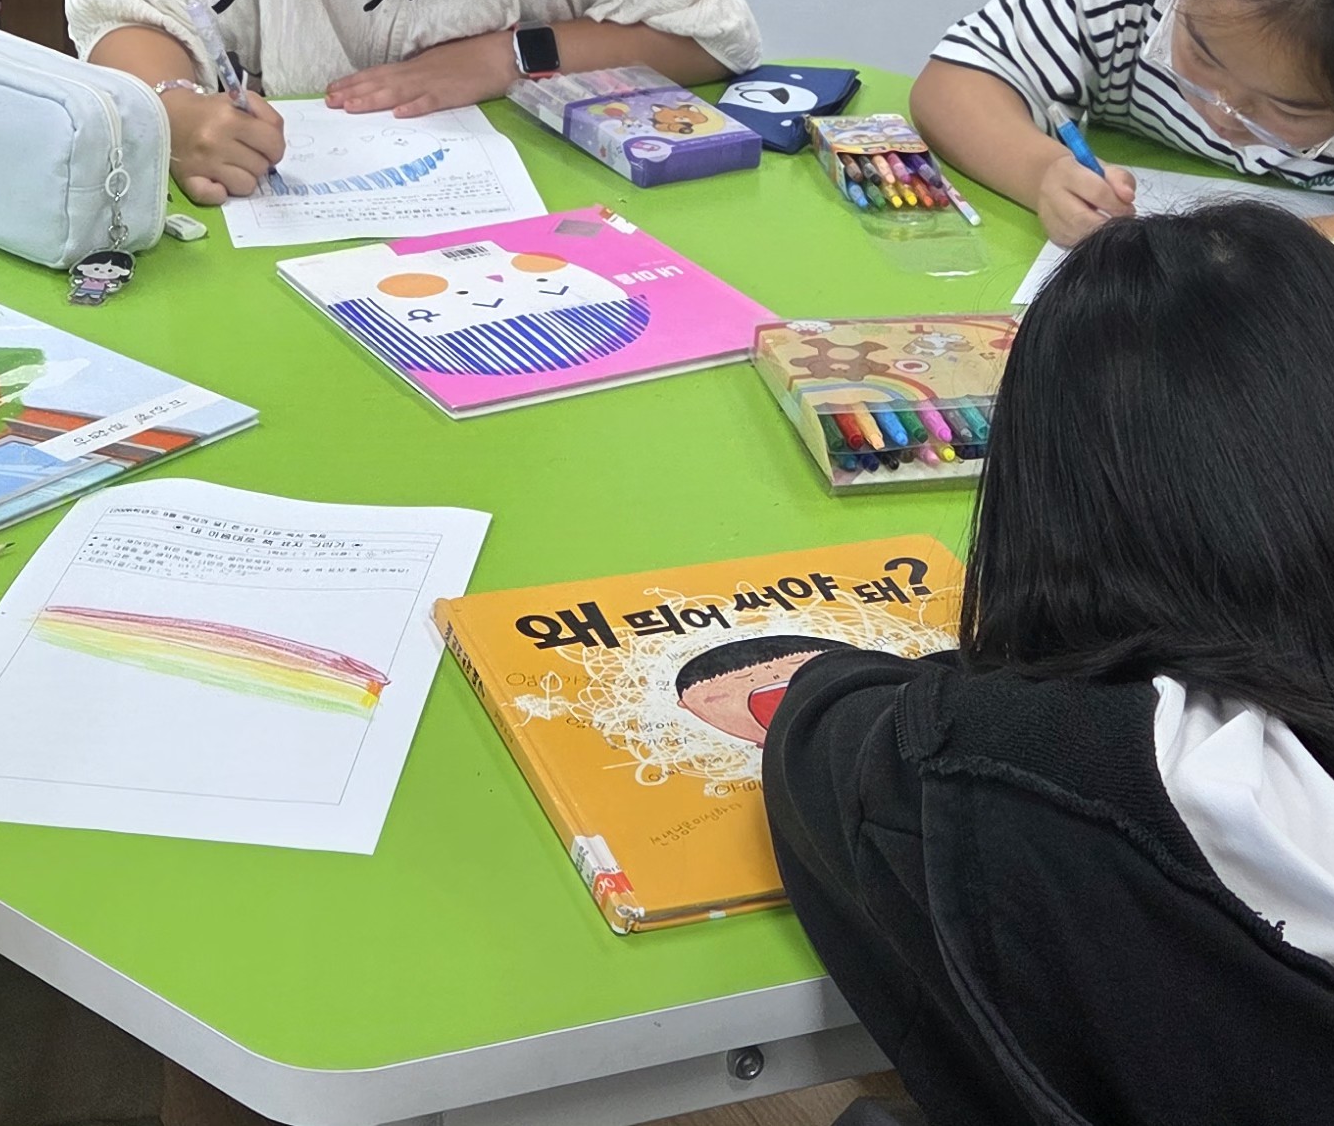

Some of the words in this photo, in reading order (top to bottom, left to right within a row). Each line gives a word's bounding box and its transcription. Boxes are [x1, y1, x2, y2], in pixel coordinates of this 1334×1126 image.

[653, 265, 684, 278] 내
[515, 601, 621, 651] 왜
[623, 604, 731, 636] 띄어
[734, 572, 840, 611] 써야
[853, 557, 935, 606] 돼?
